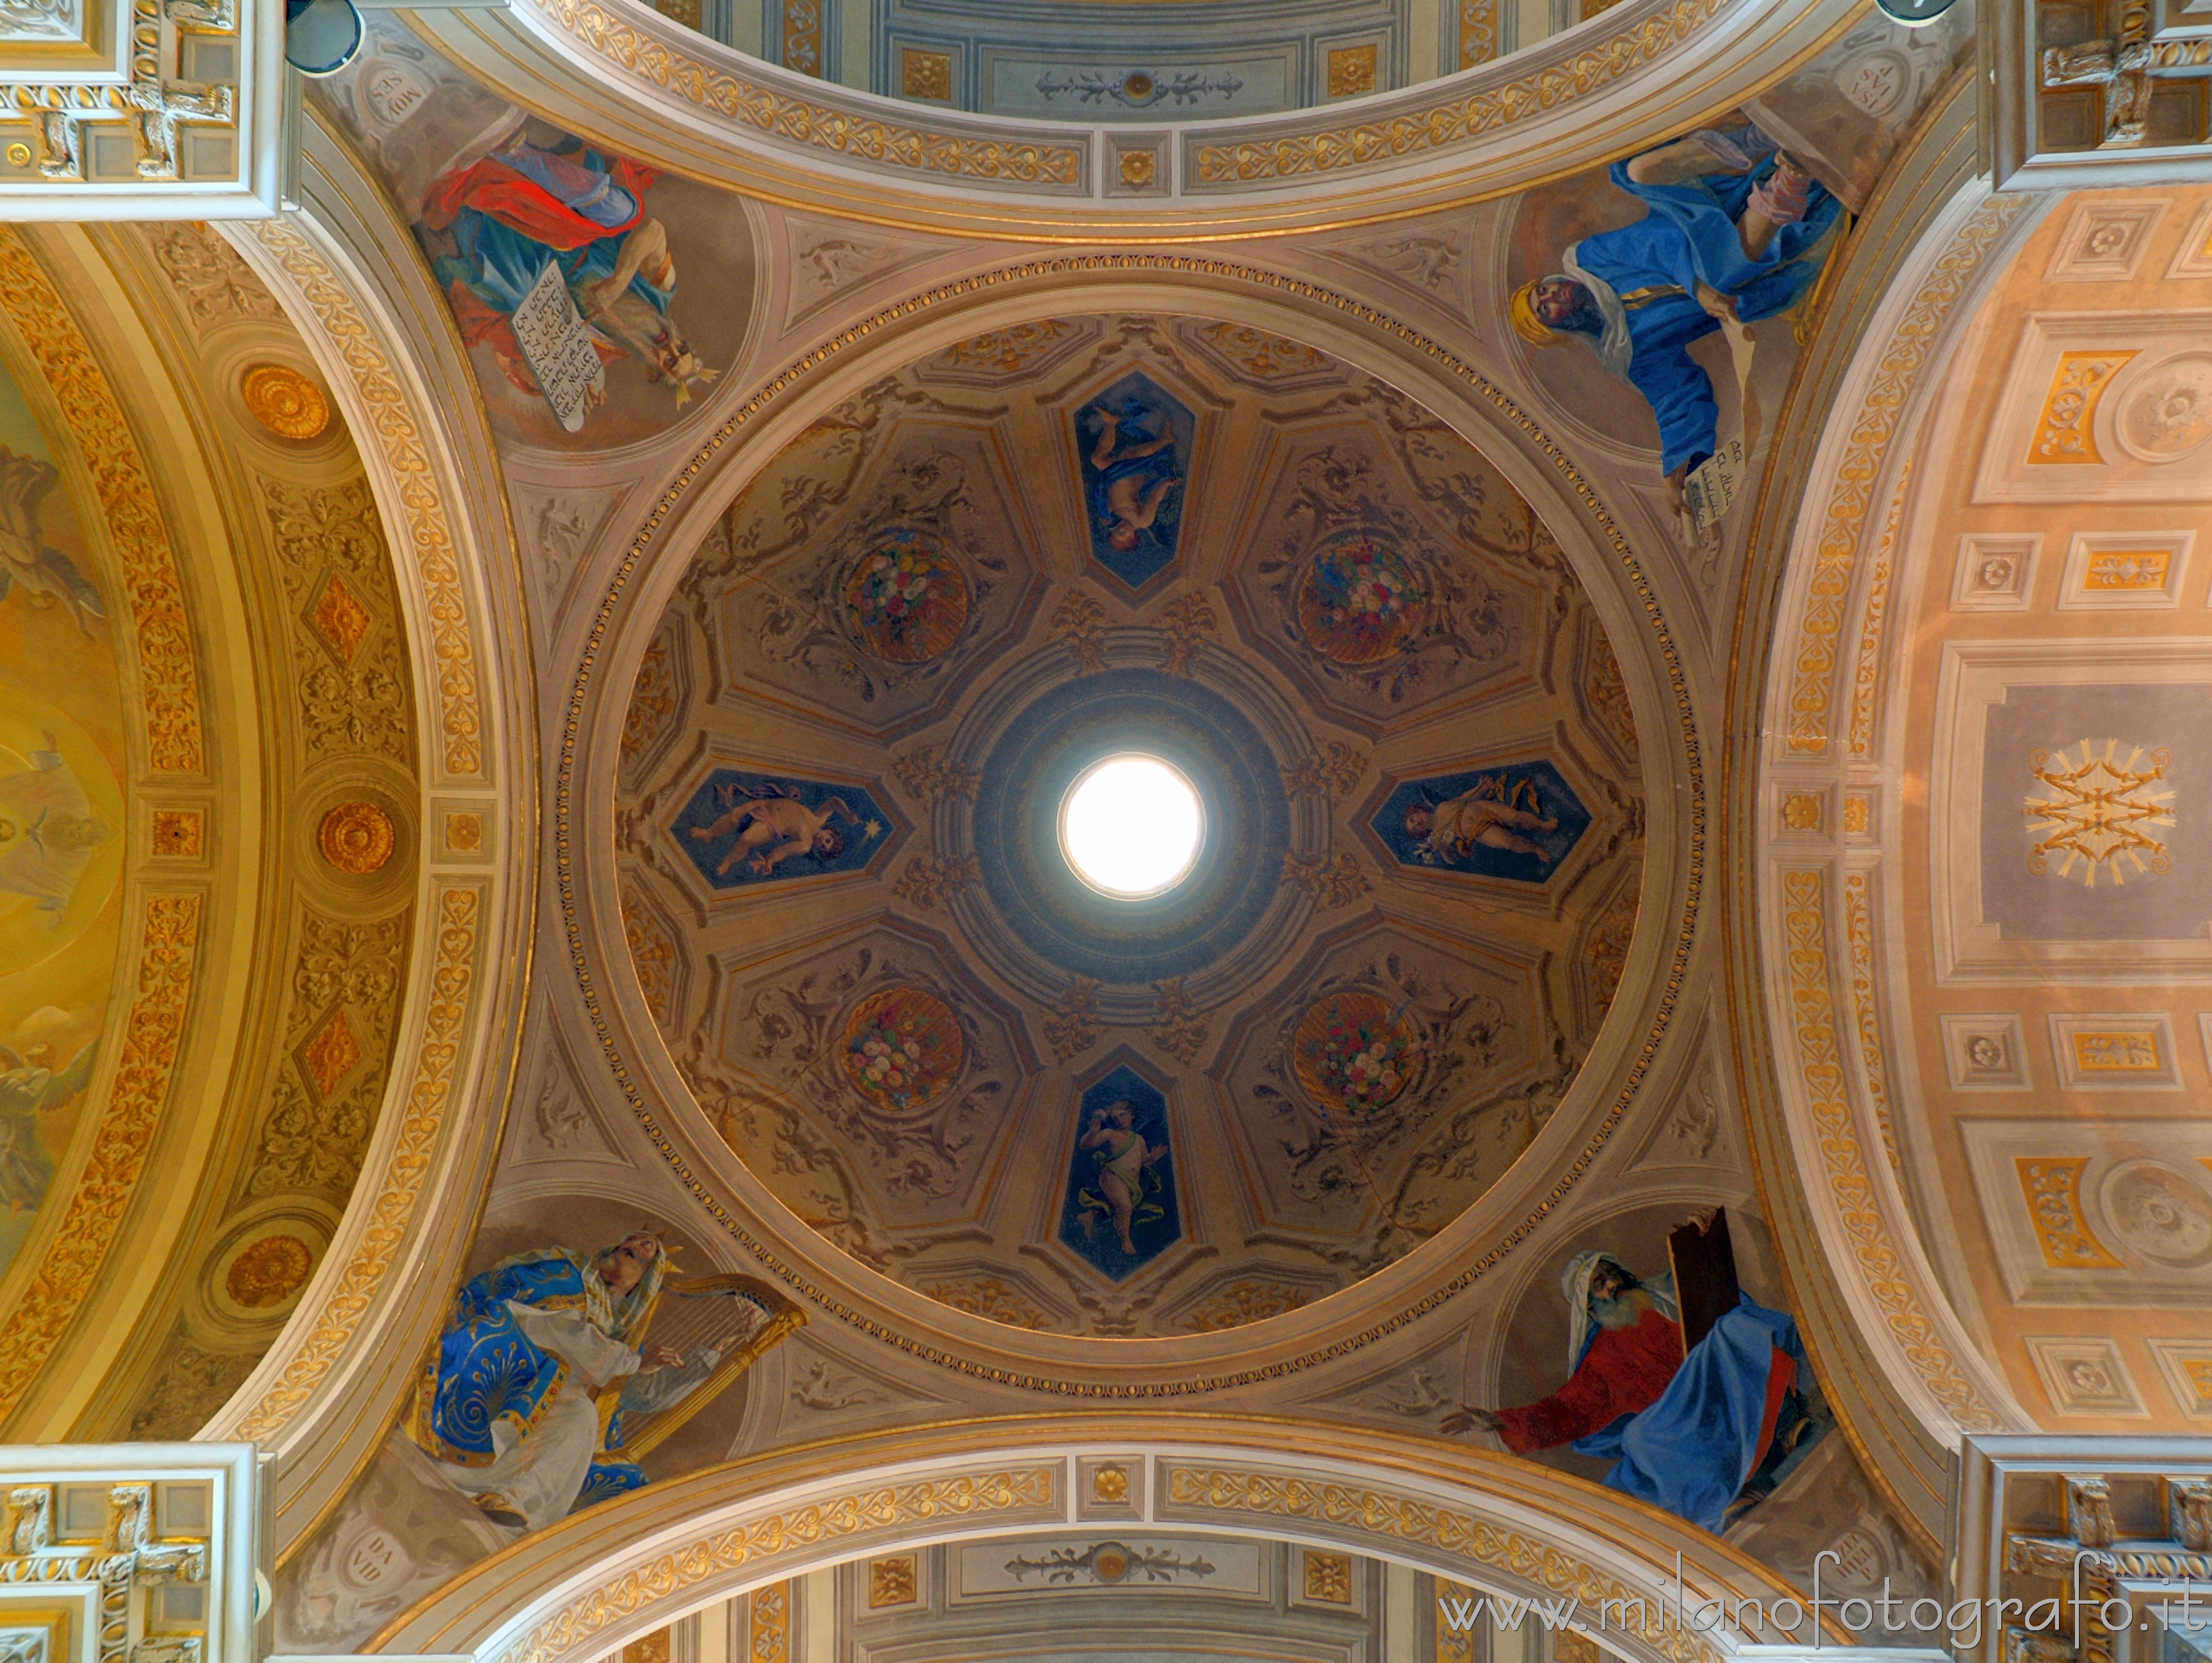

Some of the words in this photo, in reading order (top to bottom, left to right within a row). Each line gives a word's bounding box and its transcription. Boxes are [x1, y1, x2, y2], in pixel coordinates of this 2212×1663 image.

[372, 72, 402, 103] SES
[1852, 82, 1878, 109] ISA
[1859, 69, 1890, 96] IAS
[388, 87, 421, 123] MOY
[368, 1535, 393, 1565] DA
[353, 1550, 381, 1581] VID
